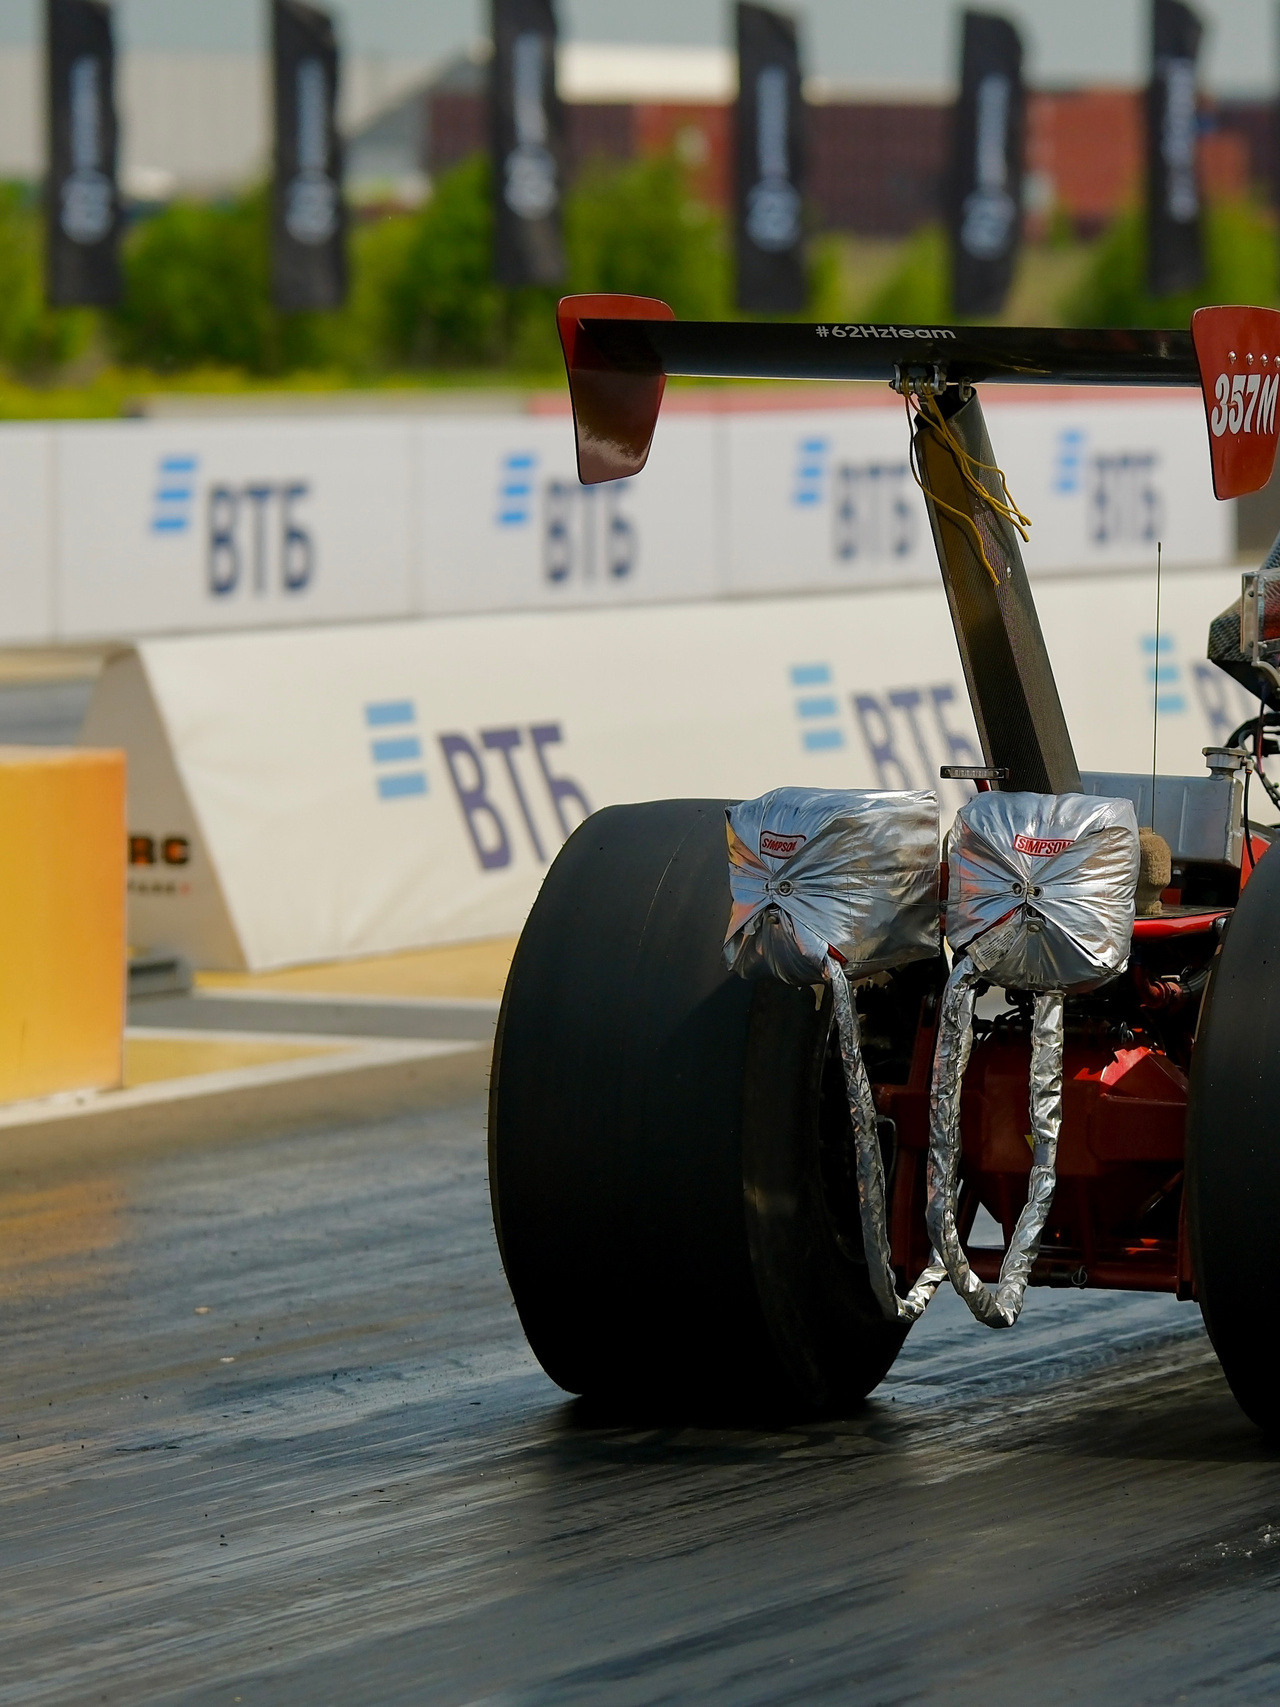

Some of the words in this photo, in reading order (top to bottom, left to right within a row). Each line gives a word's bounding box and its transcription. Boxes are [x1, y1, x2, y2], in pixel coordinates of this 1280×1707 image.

[815, 325, 957, 339] #62Hzteam
[1211, 373, 1280, 438] 357M
[206, 480, 316, 598] ВТБ
